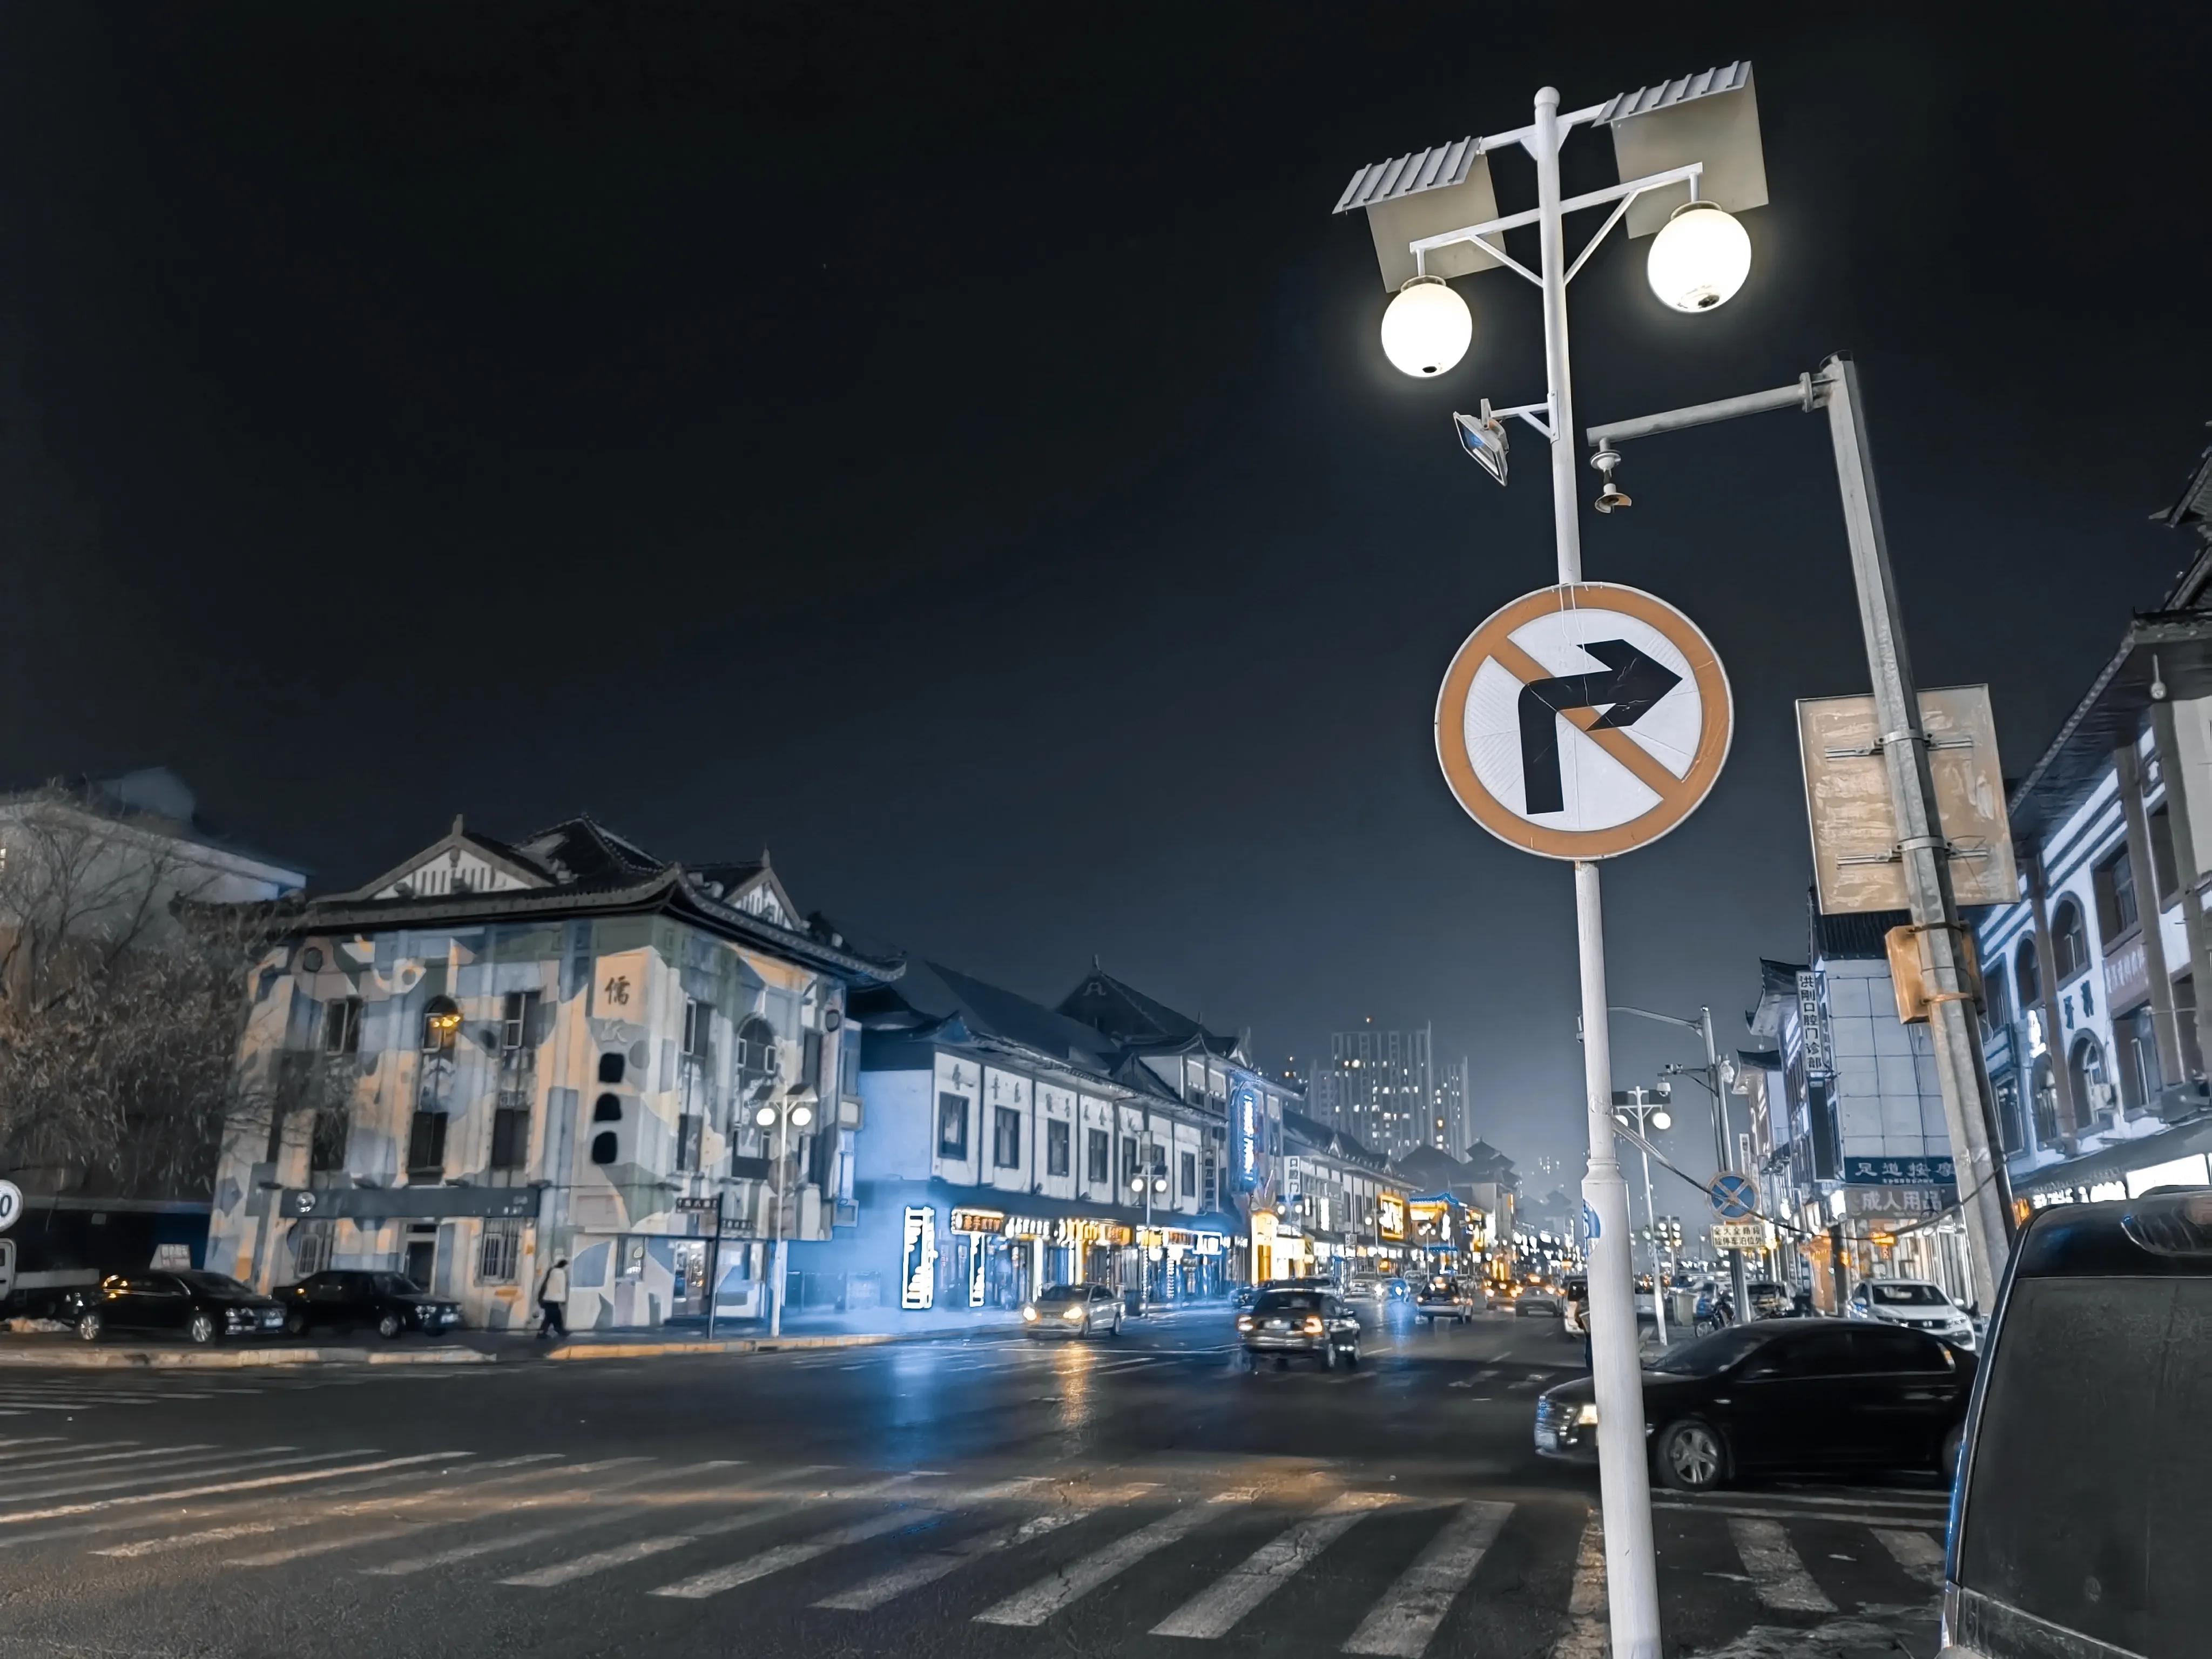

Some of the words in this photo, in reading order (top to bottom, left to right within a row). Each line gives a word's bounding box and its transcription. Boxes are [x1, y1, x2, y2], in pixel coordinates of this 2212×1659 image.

[1799, 975, 1823, 1069] 洪刚口腔门诊部
[1862, 1190, 1943, 1211] 成人用品
